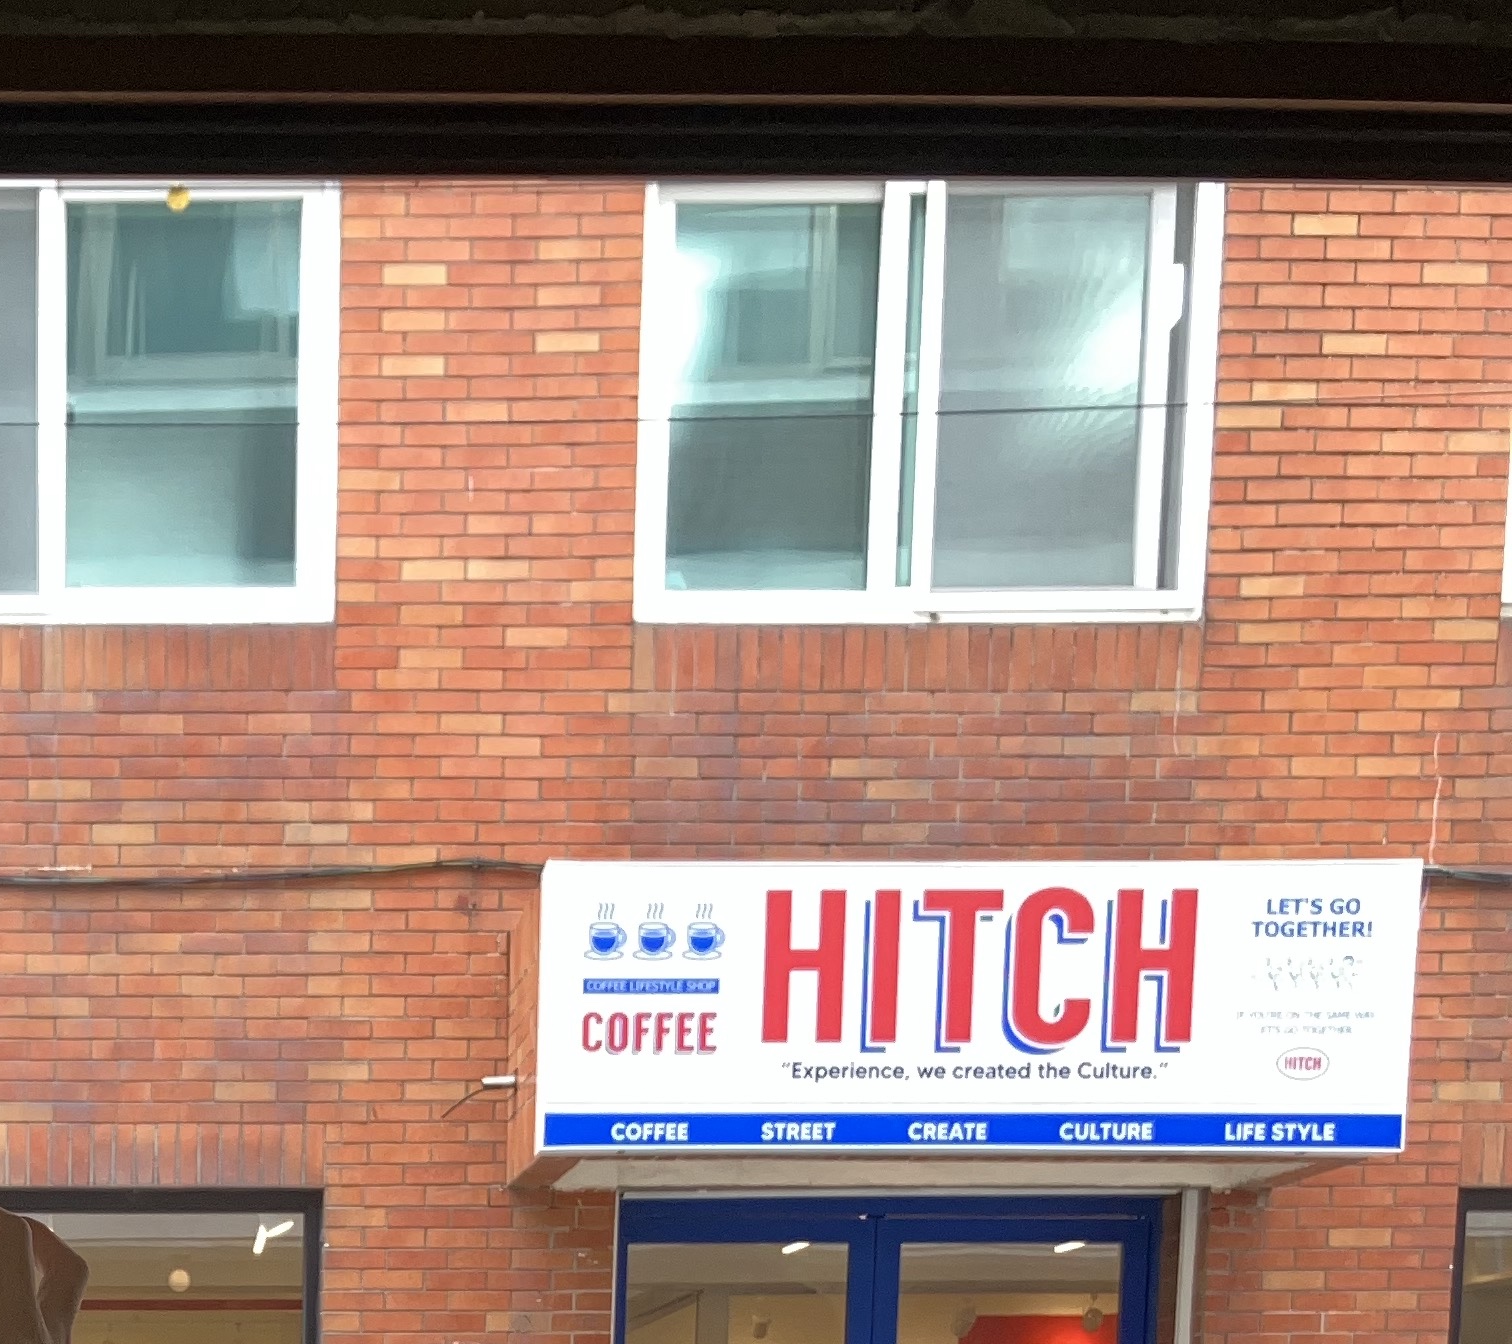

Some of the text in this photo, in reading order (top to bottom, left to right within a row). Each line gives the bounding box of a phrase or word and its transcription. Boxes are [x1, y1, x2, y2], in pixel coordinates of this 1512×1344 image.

[1266, 897, 1361, 916] LET'S GO
[1251, 920, 1373, 938] TOGETHER!
[761, 887, 1199, 1055] HITCH
[587, 980, 716, 993] COFFEE LIFESTYLE SHOP
[582, 1011, 718, 1056] COFFEE
[917, 1067, 947, 1079] we
[952, 1062, 1031, 1080] created
[1038, 1062, 1071, 1080] the
[1284, 1056, 1322, 1070] HITCH
[610, 1122, 688, 1142] COFFEE
[760, 1121, 836, 1141] STREET
[907, 1121, 987, 1141] CREATE
[1059, 1122, 1153, 1142] CULTURE
[1224, 1122, 1336, 1142] LIFE STYLE
